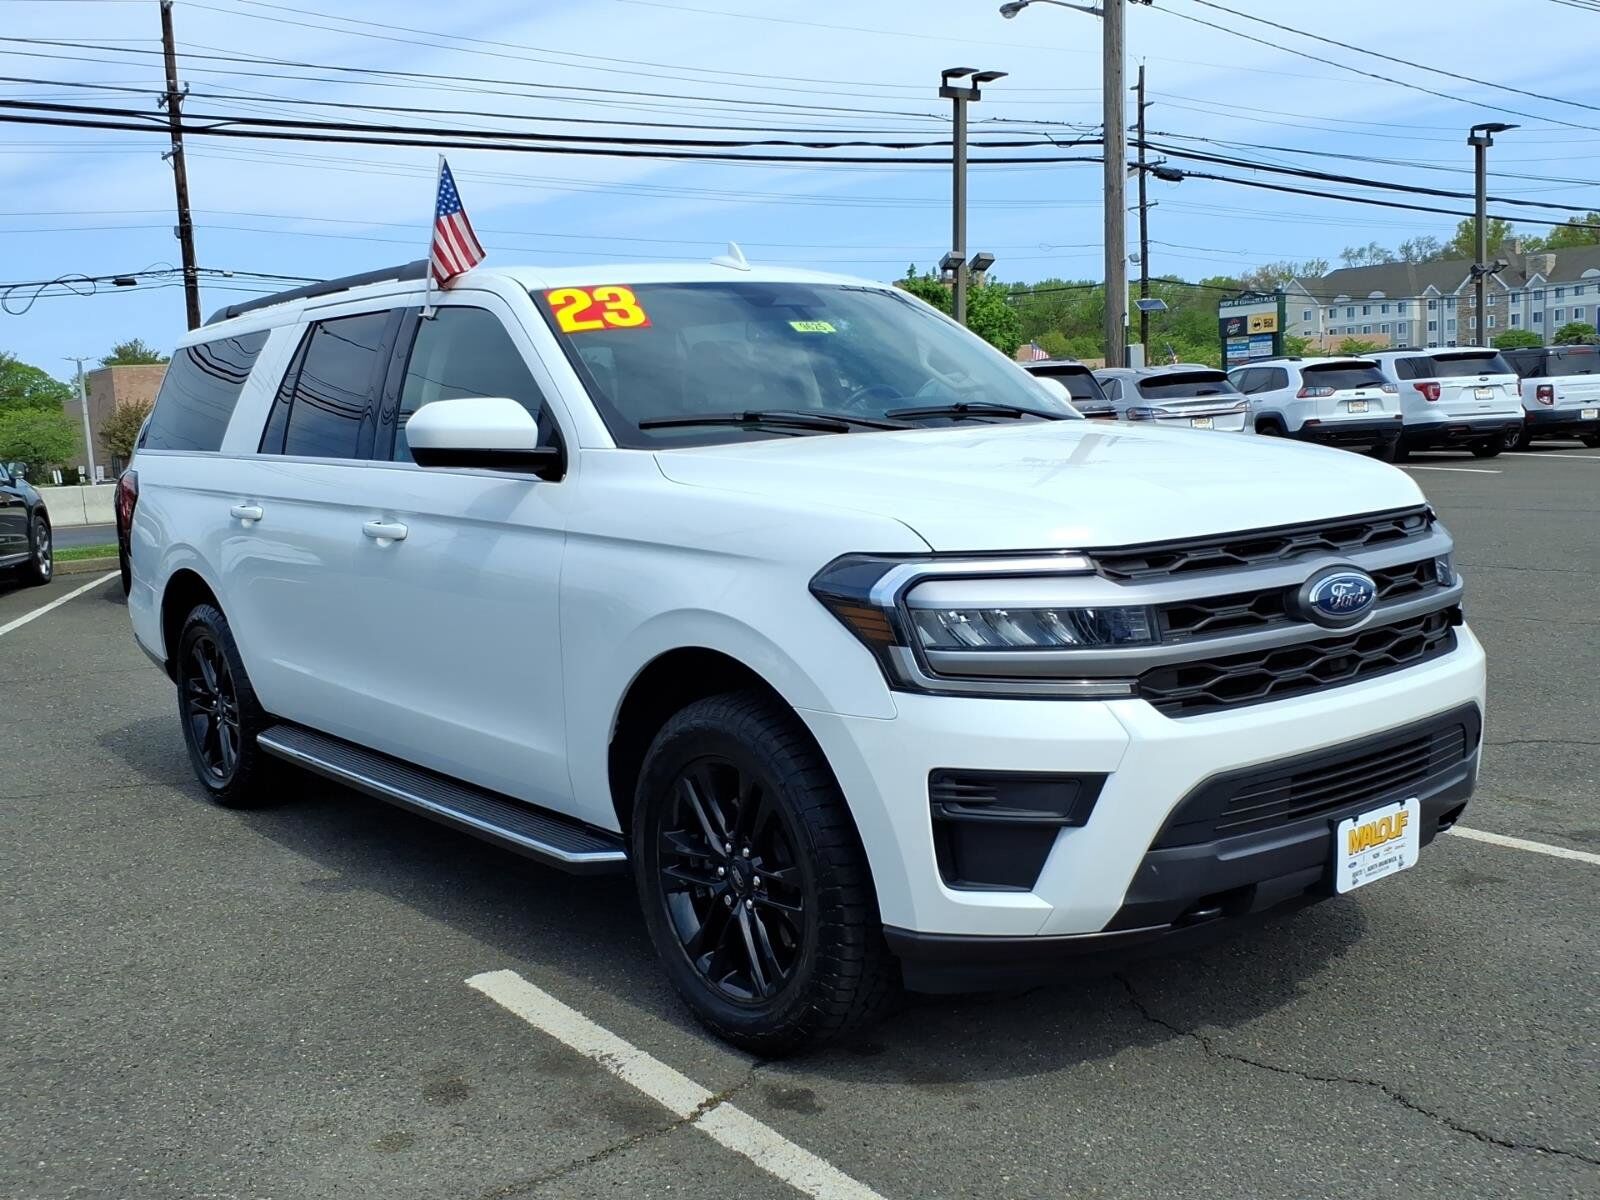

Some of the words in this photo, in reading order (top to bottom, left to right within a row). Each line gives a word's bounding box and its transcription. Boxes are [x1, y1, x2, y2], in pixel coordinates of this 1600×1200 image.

[548, 286, 646, 333] 23
[1330, 582, 1367, 609] Ford
[1348, 810, 1409, 856] MALOUF
